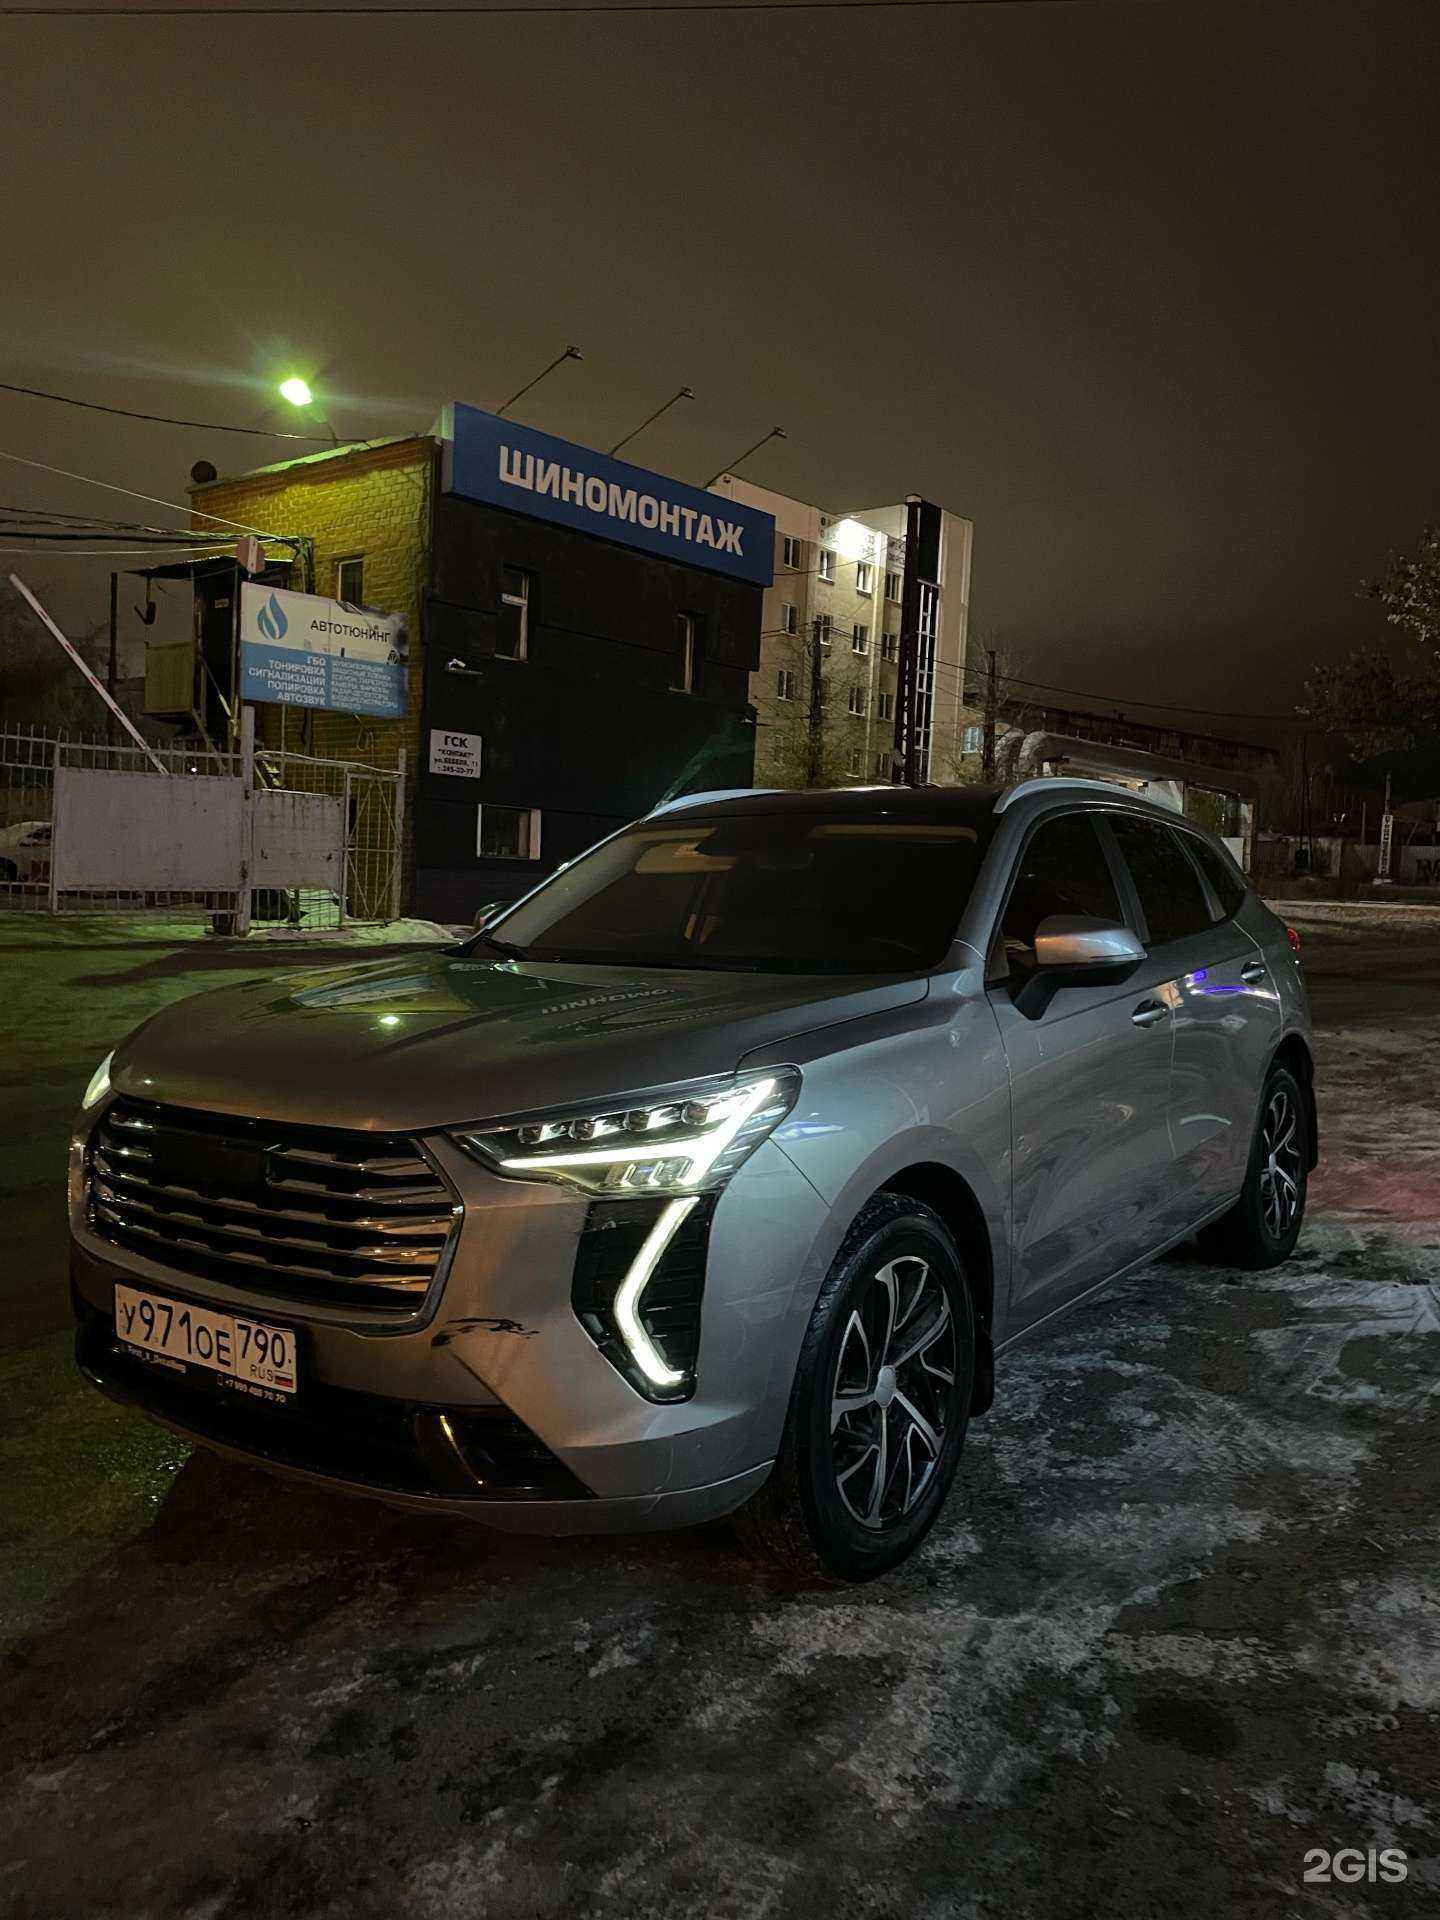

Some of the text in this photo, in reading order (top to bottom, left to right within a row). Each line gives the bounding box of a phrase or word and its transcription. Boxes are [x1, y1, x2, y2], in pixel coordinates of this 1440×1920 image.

[499, 445, 744, 556] ШИНОМОНТАЖ
[311, 619, 392, 643] АВТОТЮНИНГ
[268, 659, 326, 677] ТОНИРОВКА
[306, 656, 326, 666] ГБО
[267, 680, 326, 696] ПОЛИРОВКА
[276, 692, 326, 706] АВТОЗВУК
[444, 735, 468, 748] ГСК
[237, 1323, 286, 1368] 790
[250, 1364, 276, 1383] RUS
